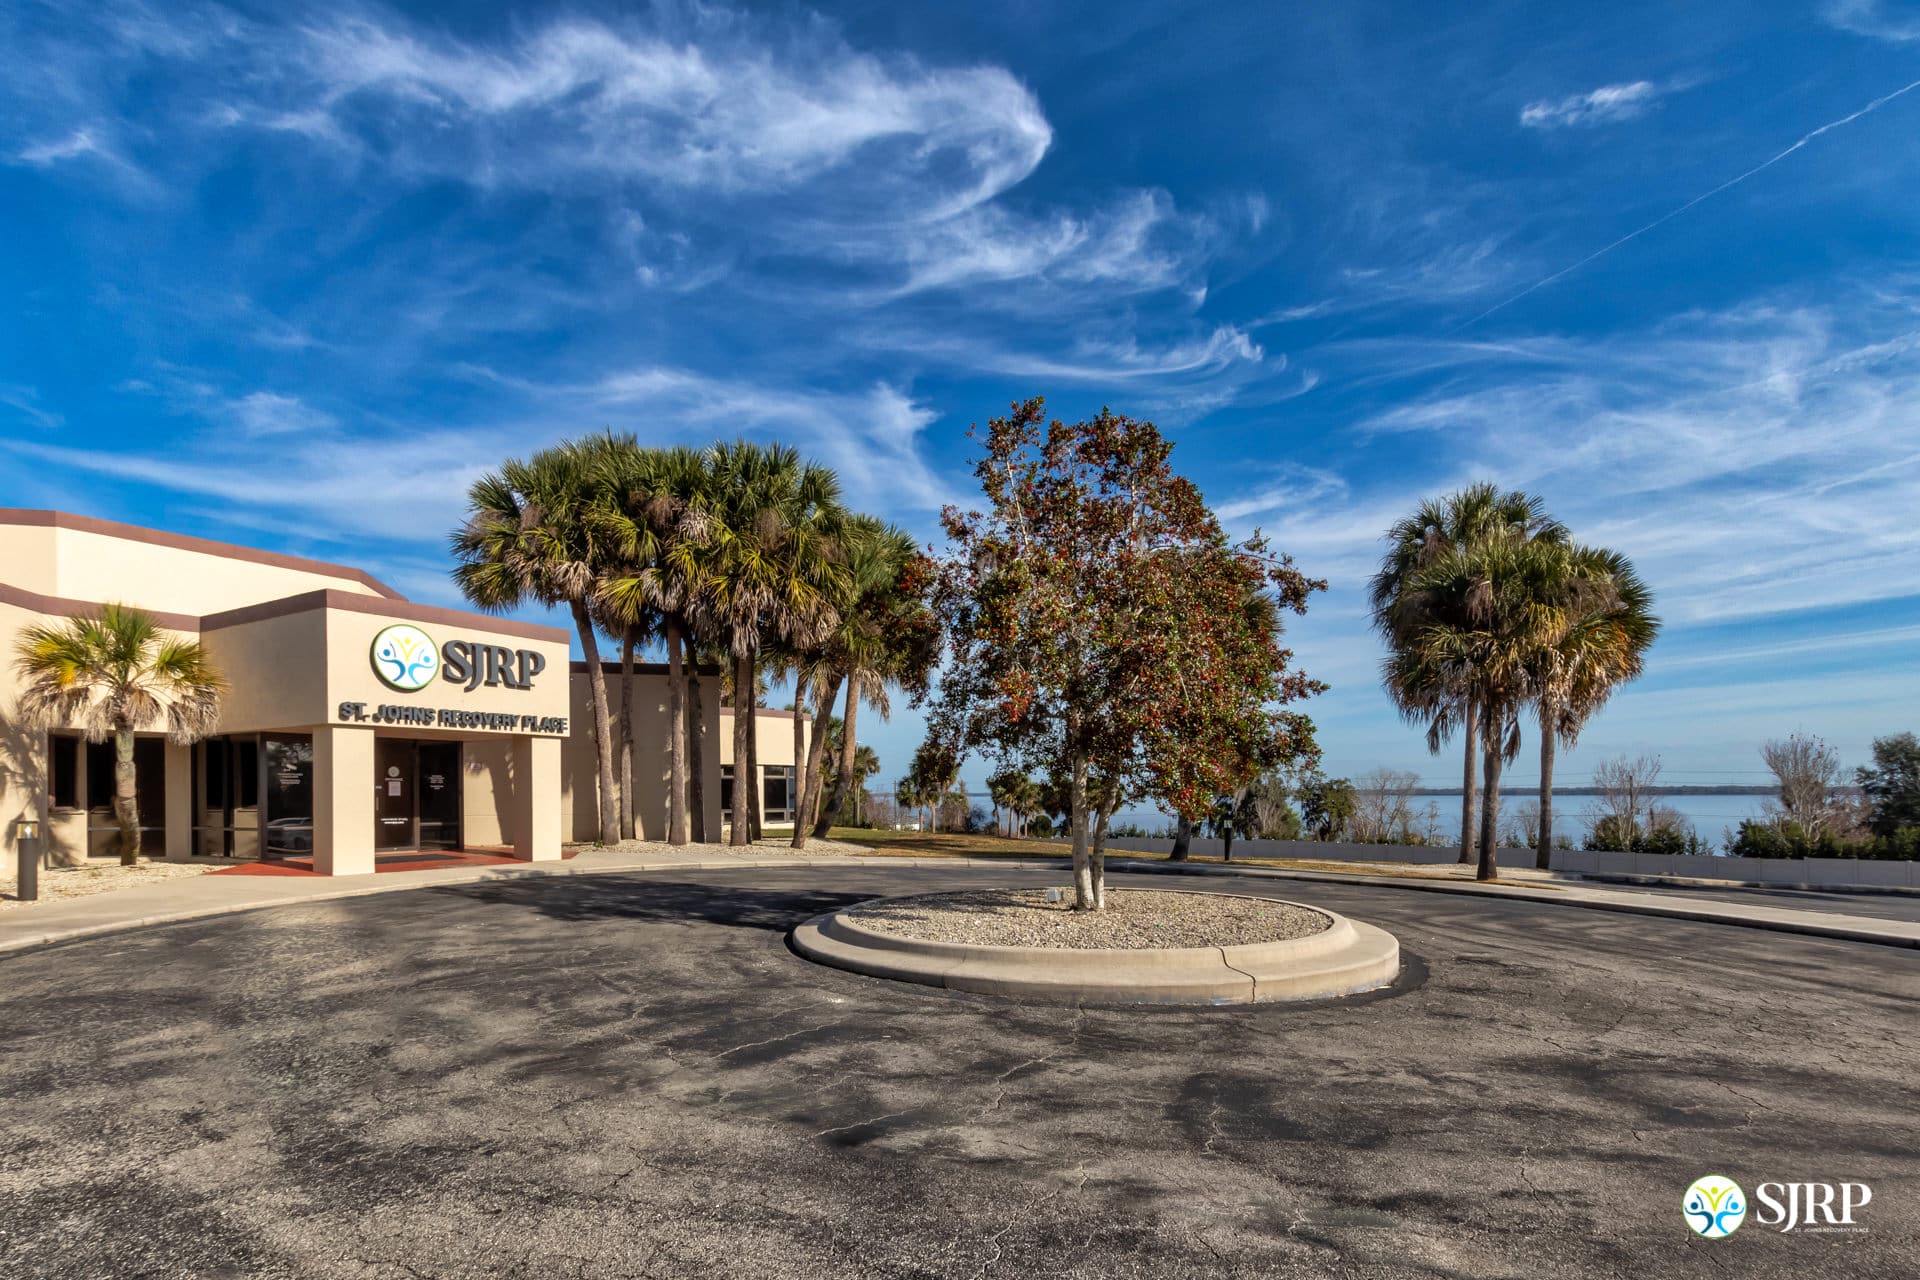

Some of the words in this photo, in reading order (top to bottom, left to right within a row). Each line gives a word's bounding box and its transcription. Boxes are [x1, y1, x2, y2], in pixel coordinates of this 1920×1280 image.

[441, 640, 546, 693] SJRP
[338, 702, 370, 722] ST.
[372, 704, 437, 726] JOHNS
[438, 709, 520, 731] RECOVERY
[521, 715, 568, 734] PLACE
